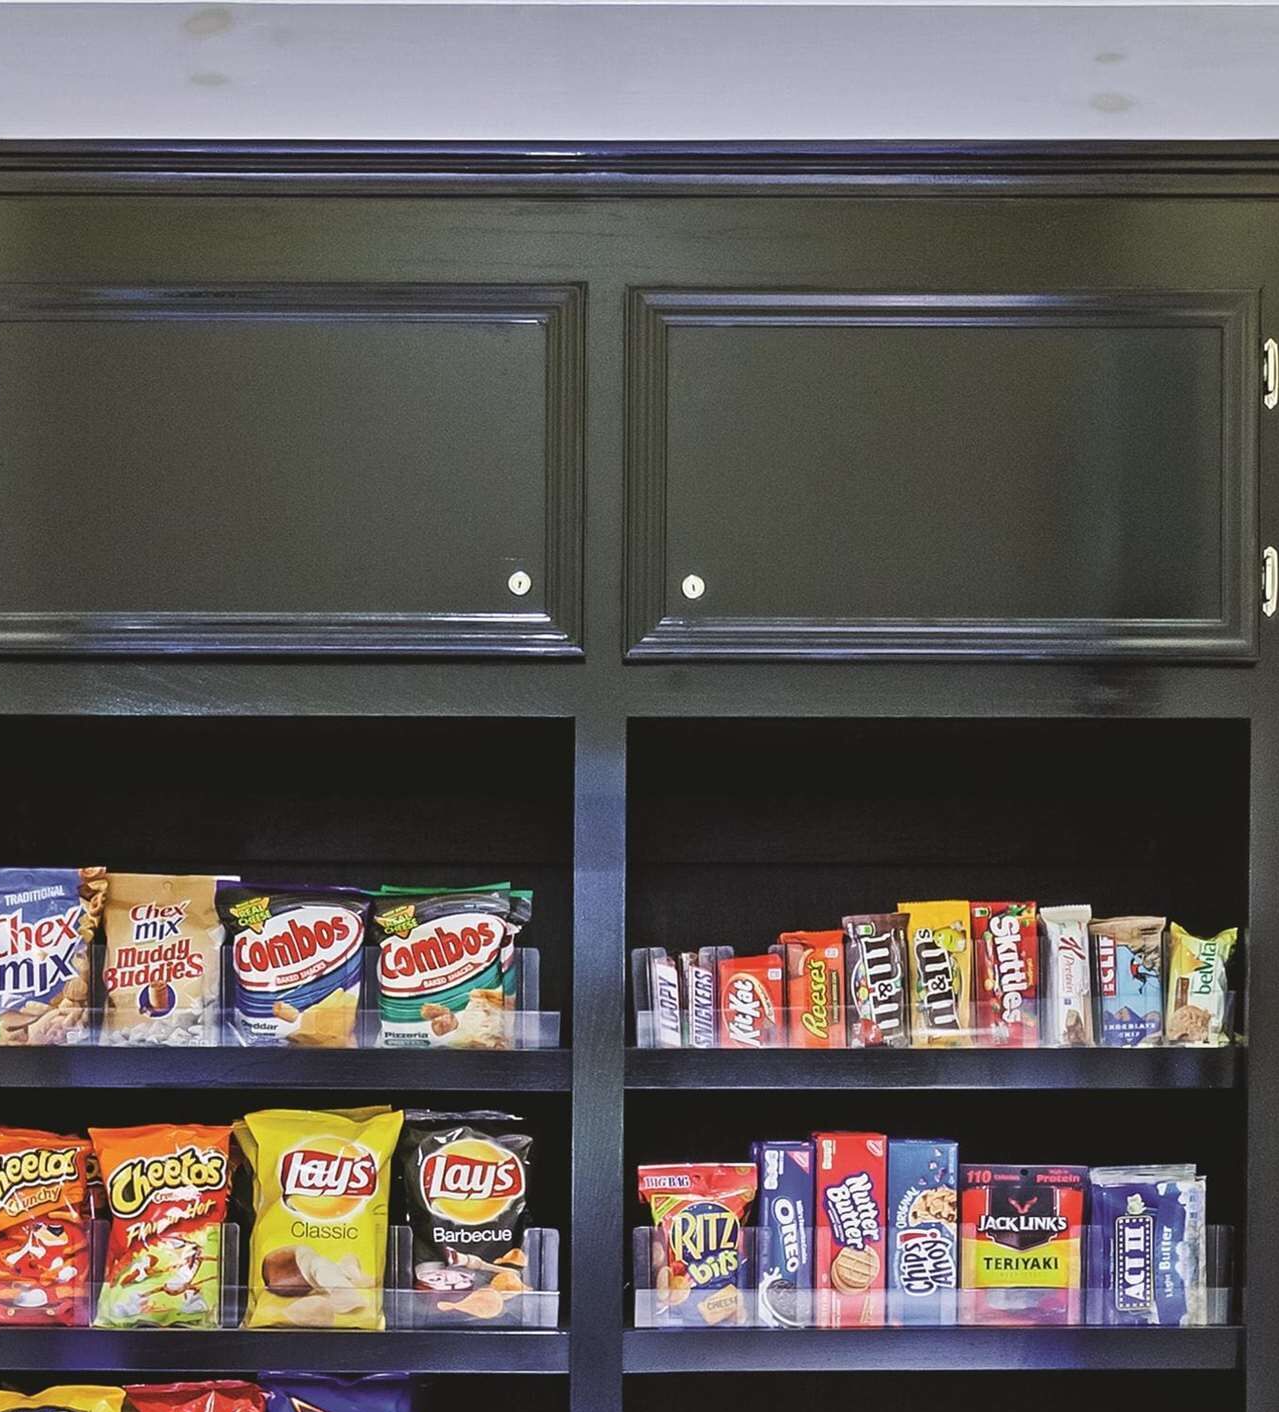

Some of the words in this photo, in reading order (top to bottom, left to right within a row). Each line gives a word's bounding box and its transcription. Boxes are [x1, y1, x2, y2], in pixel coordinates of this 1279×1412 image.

[4, 885, 65, 906] TRADITIONAL
[130, 902, 187, 921] Chex
[135, 917, 183, 940] mix
[235, 916, 350, 973] Combos
[380, 922, 496, 979] Combos
[989, 915, 1028, 1022] Skittles
[694, 969, 713, 1047] SNICKERS
[801, 959, 827, 1039] Reese's
[110, 1150, 225, 1215] Cheetos
[285, 1152, 373, 1196] Lay's
[428, 1155, 516, 1200] Lay's
[967, 1170, 992, 1183] 110
[290, 1221, 359, 1240] Classic
[433, 1226, 512, 1244] Barbecue
[673, 1211, 736, 1261] RITZ
[774, 1198, 799, 1273] OREO
[978, 1215, 1020, 1231] JACK
[984, 1257, 1059, 1270] TERIYAKI
[1124, 1256, 1146, 1300] ACT
